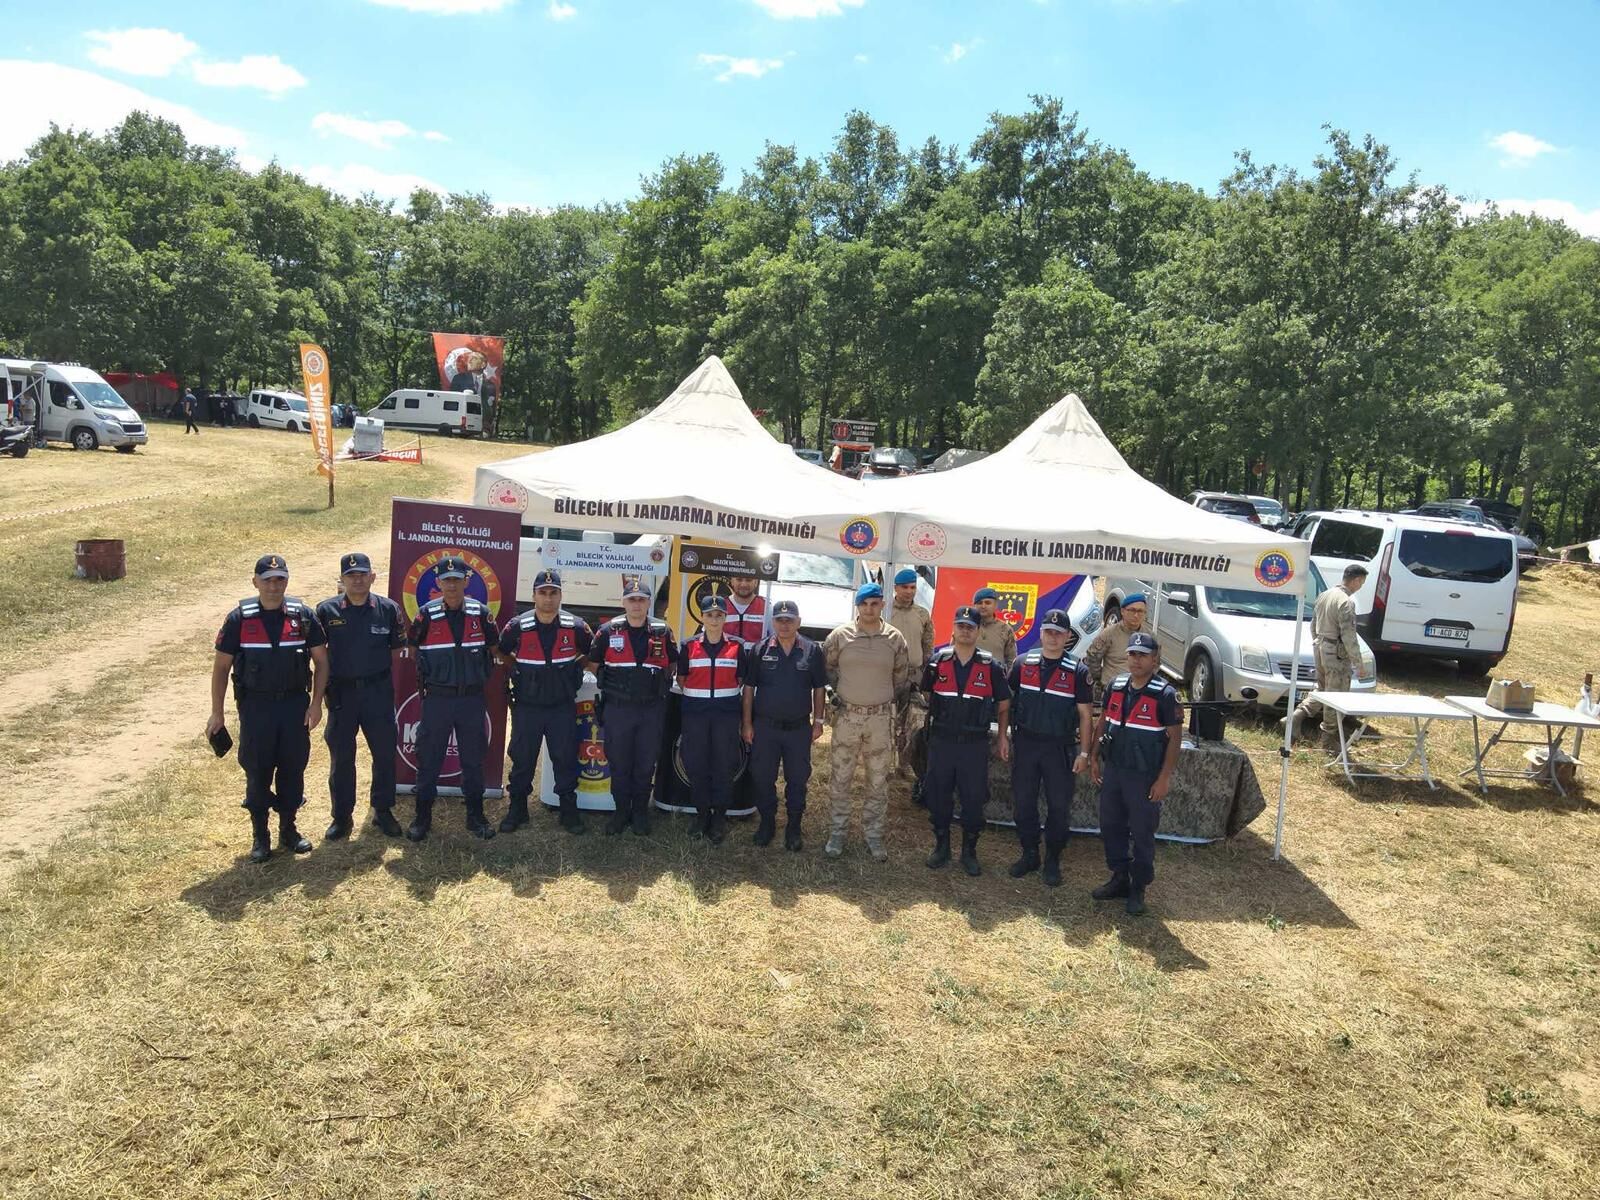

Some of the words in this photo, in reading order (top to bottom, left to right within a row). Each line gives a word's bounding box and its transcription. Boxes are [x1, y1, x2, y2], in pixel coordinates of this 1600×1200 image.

[554, 497, 613, 518] BİLECİK
[617, 500, 630, 518] İL
[633, 503, 713, 526] JANDARMA
[717, 511, 816, 539] KOMUTANLIĞI
[422, 522, 454, 534] BİLECİK
[456, 526, 491, 538] VALİLİĞİ
[398, 530, 406, 540] İL
[407, 533, 455, 546] JANDARMA
[456, 538, 513, 551] KOMUTANLIĞI
[600, 545, 612, 553] T.C.
[971, 537, 1028, 557] BİLECİK
[1032, 539, 1044, 557] İL
[1047, 541, 1126, 563] JANDARMA
[1130, 547, 1231, 573] KOMUTANLIĞI
[556, 558, 564, 566] İL
[564, 560, 604, 569] JANDARMA
[605, 563, 654, 572] KOMUTANLIĞI
[576, 552, 604, 561] BİLECİK
[605, 554, 635, 563] VALİLİĞİ
[409, 551, 497, 590] JANDARMA
[1455, 630, 1467, 638] 874
